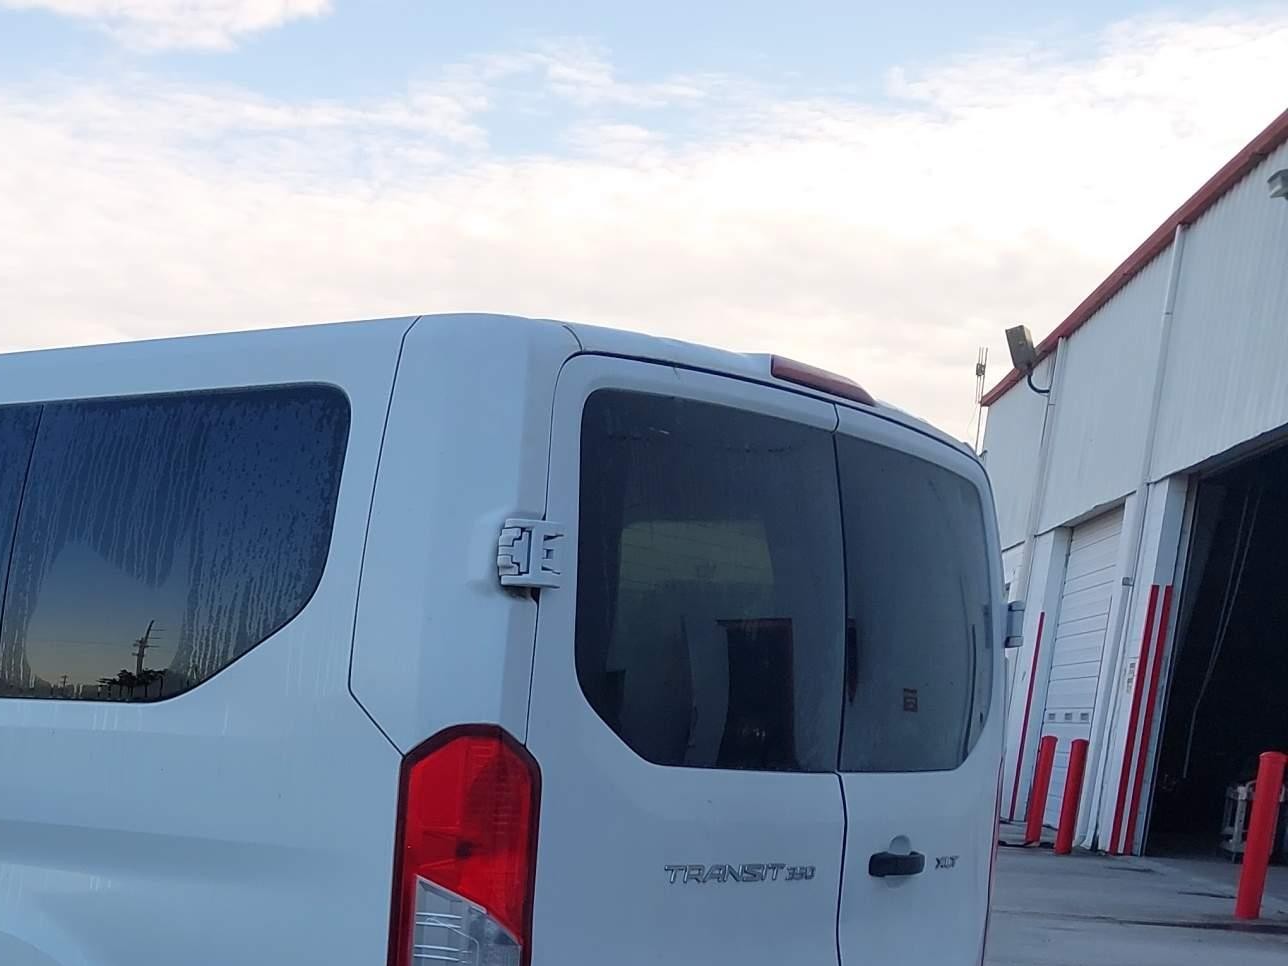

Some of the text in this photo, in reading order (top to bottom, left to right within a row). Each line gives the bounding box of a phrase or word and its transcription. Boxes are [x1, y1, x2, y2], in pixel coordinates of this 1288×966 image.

[935, 855, 960, 870] XLT
[664, 863, 816, 884] TRANSIT 350
